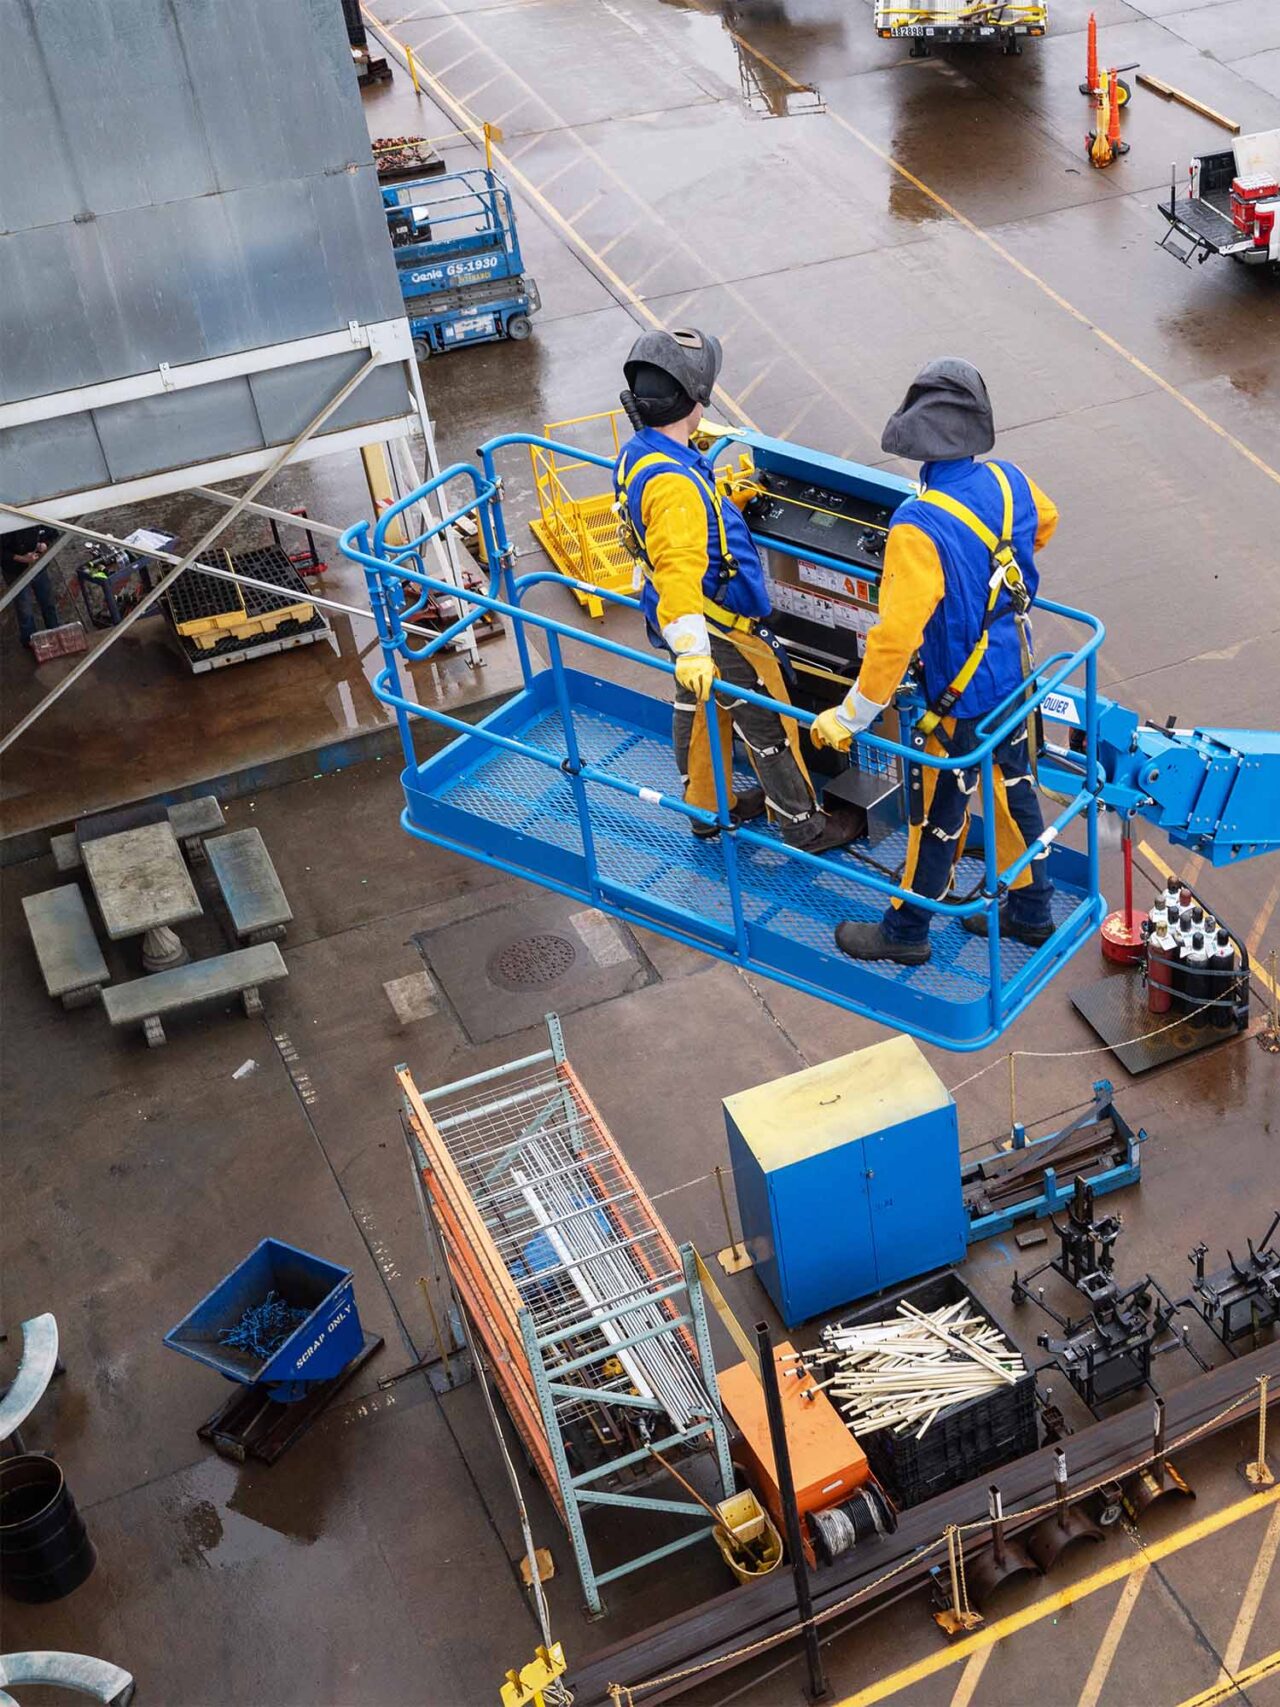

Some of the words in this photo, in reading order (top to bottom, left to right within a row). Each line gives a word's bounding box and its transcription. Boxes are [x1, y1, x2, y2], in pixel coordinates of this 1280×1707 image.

[411, 269, 443, 283] Genie
[446, 256, 498, 276] GS-1930
[296, 1333, 325, 1369] SCRAP
[327, 1303, 352, 1333] ONLY
